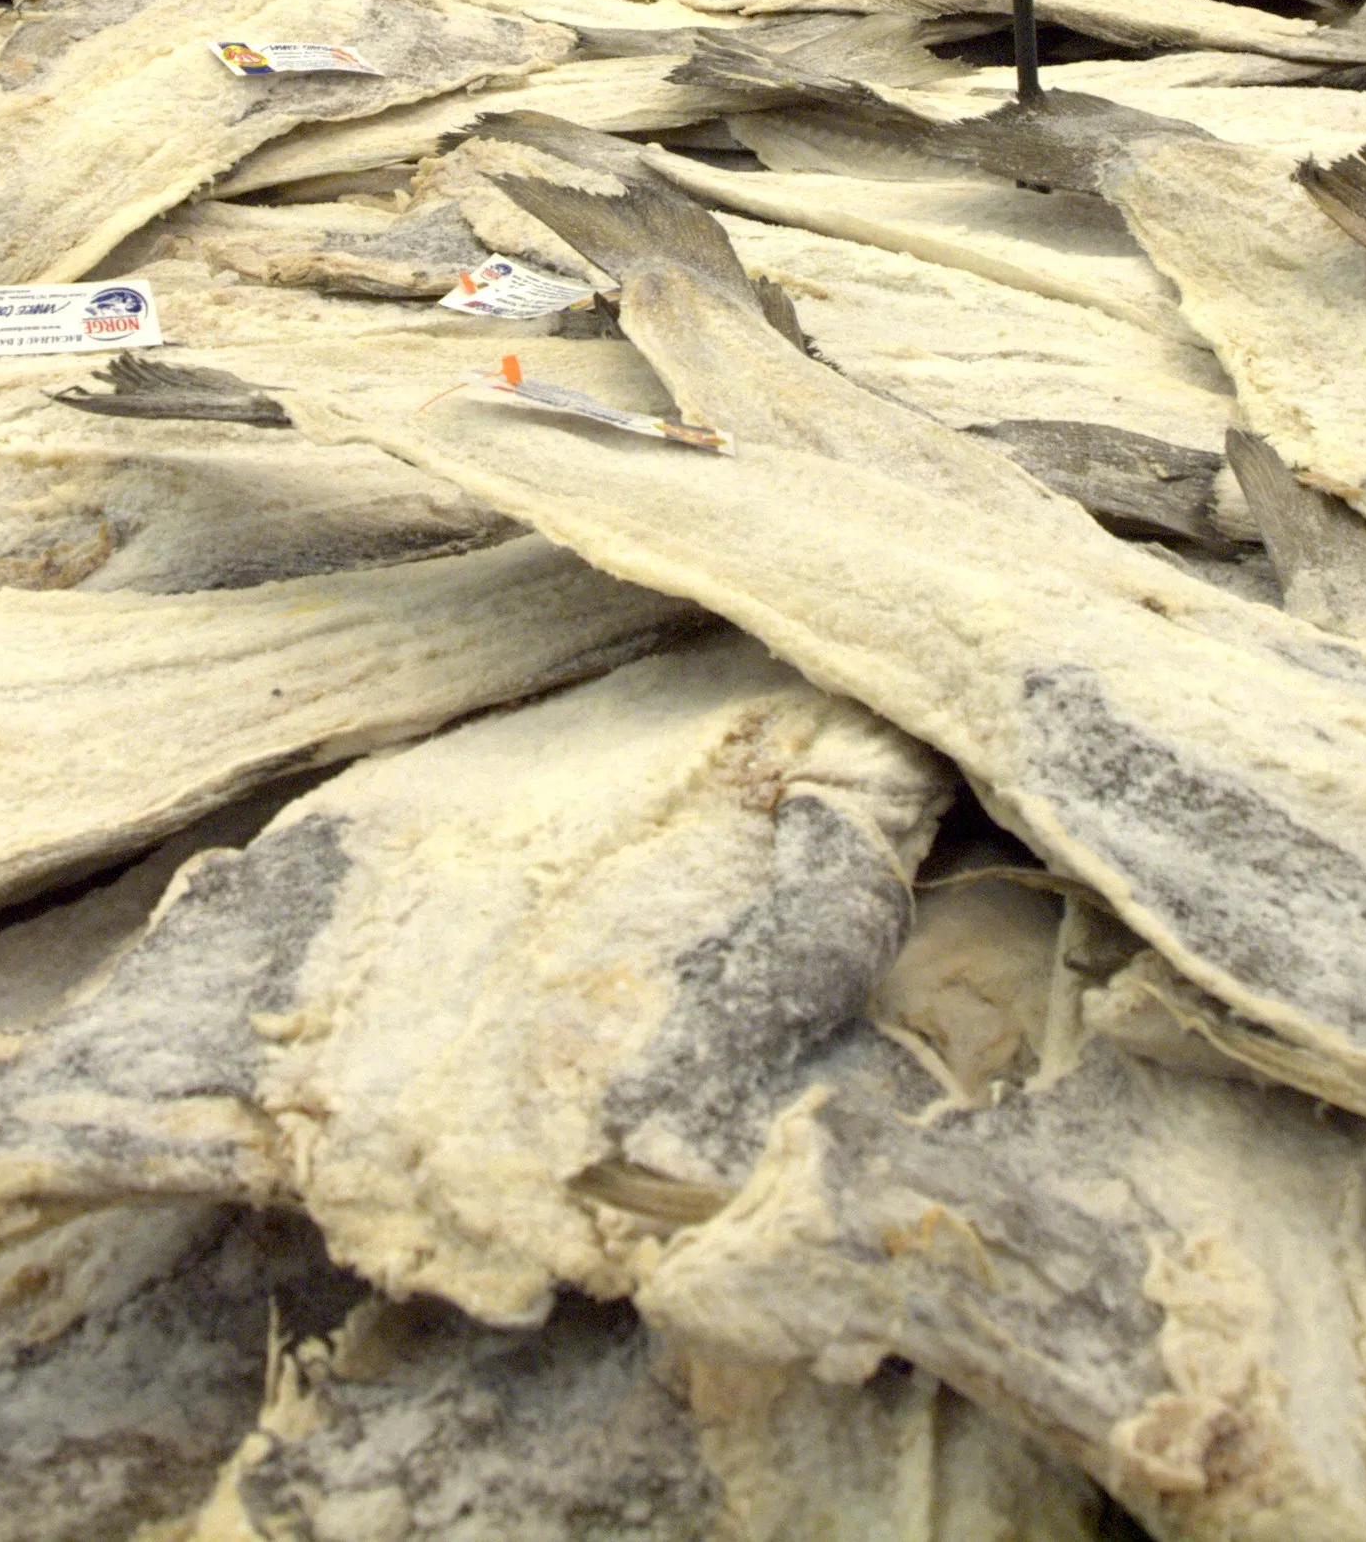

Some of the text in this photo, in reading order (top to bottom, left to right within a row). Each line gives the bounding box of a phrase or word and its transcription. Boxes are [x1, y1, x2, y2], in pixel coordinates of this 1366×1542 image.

[82, 316, 140, 335] NORGE
[0, 337, 14, 347] DA
[26, 333, 82, 345] BACALHAU
